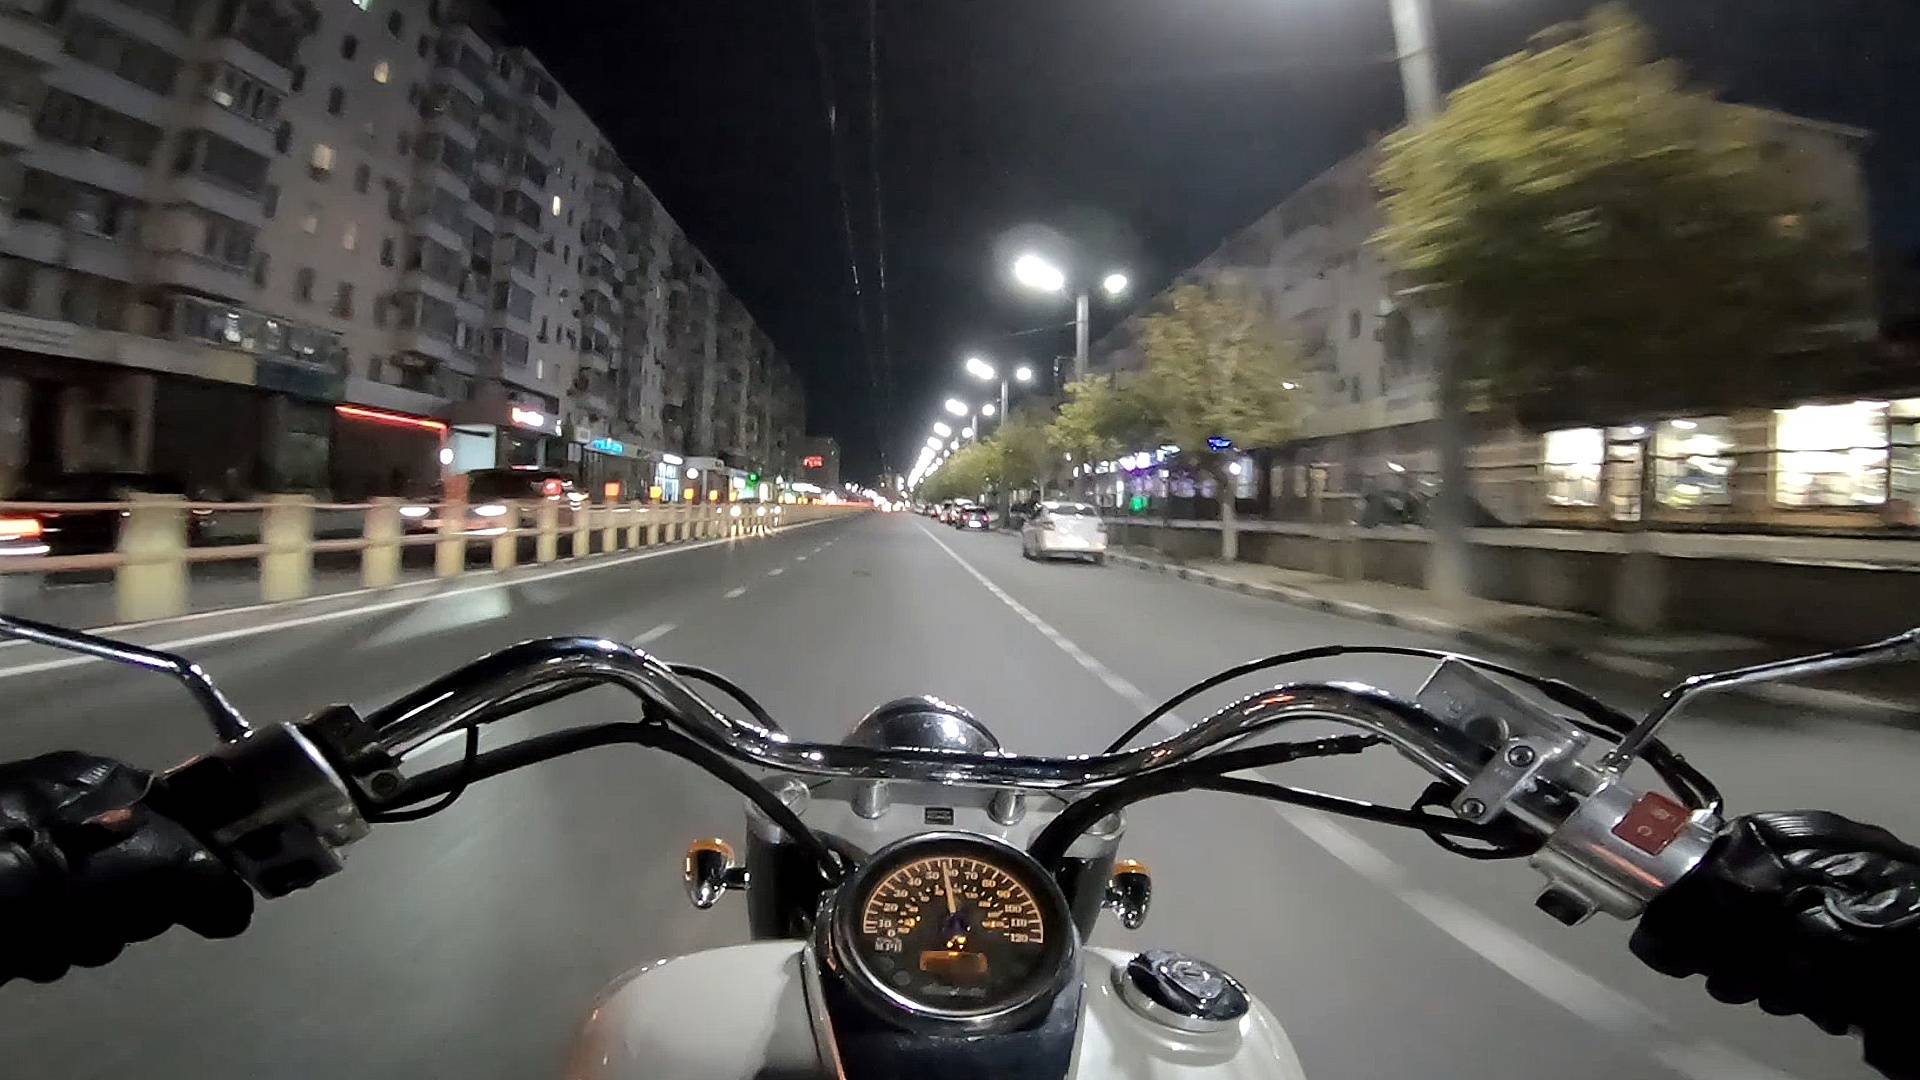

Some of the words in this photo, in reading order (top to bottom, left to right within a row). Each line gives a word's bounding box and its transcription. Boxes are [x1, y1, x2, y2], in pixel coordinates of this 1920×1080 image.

[925, 870, 940, 880] 50
[964, 871, 979, 880] 70
[907, 877, 922, 886] 40
[893, 889, 909, 898] 30
[996, 890, 1011, 899] 90
[883, 902, 898, 912] 20
[1004, 904, 1022, 913] 100
[879, 919, 892, 928] 10
[1010, 918, 1028, 927] 110
[1010, 933, 1029, 943] 120
[874, 940, 902, 952] MPH
